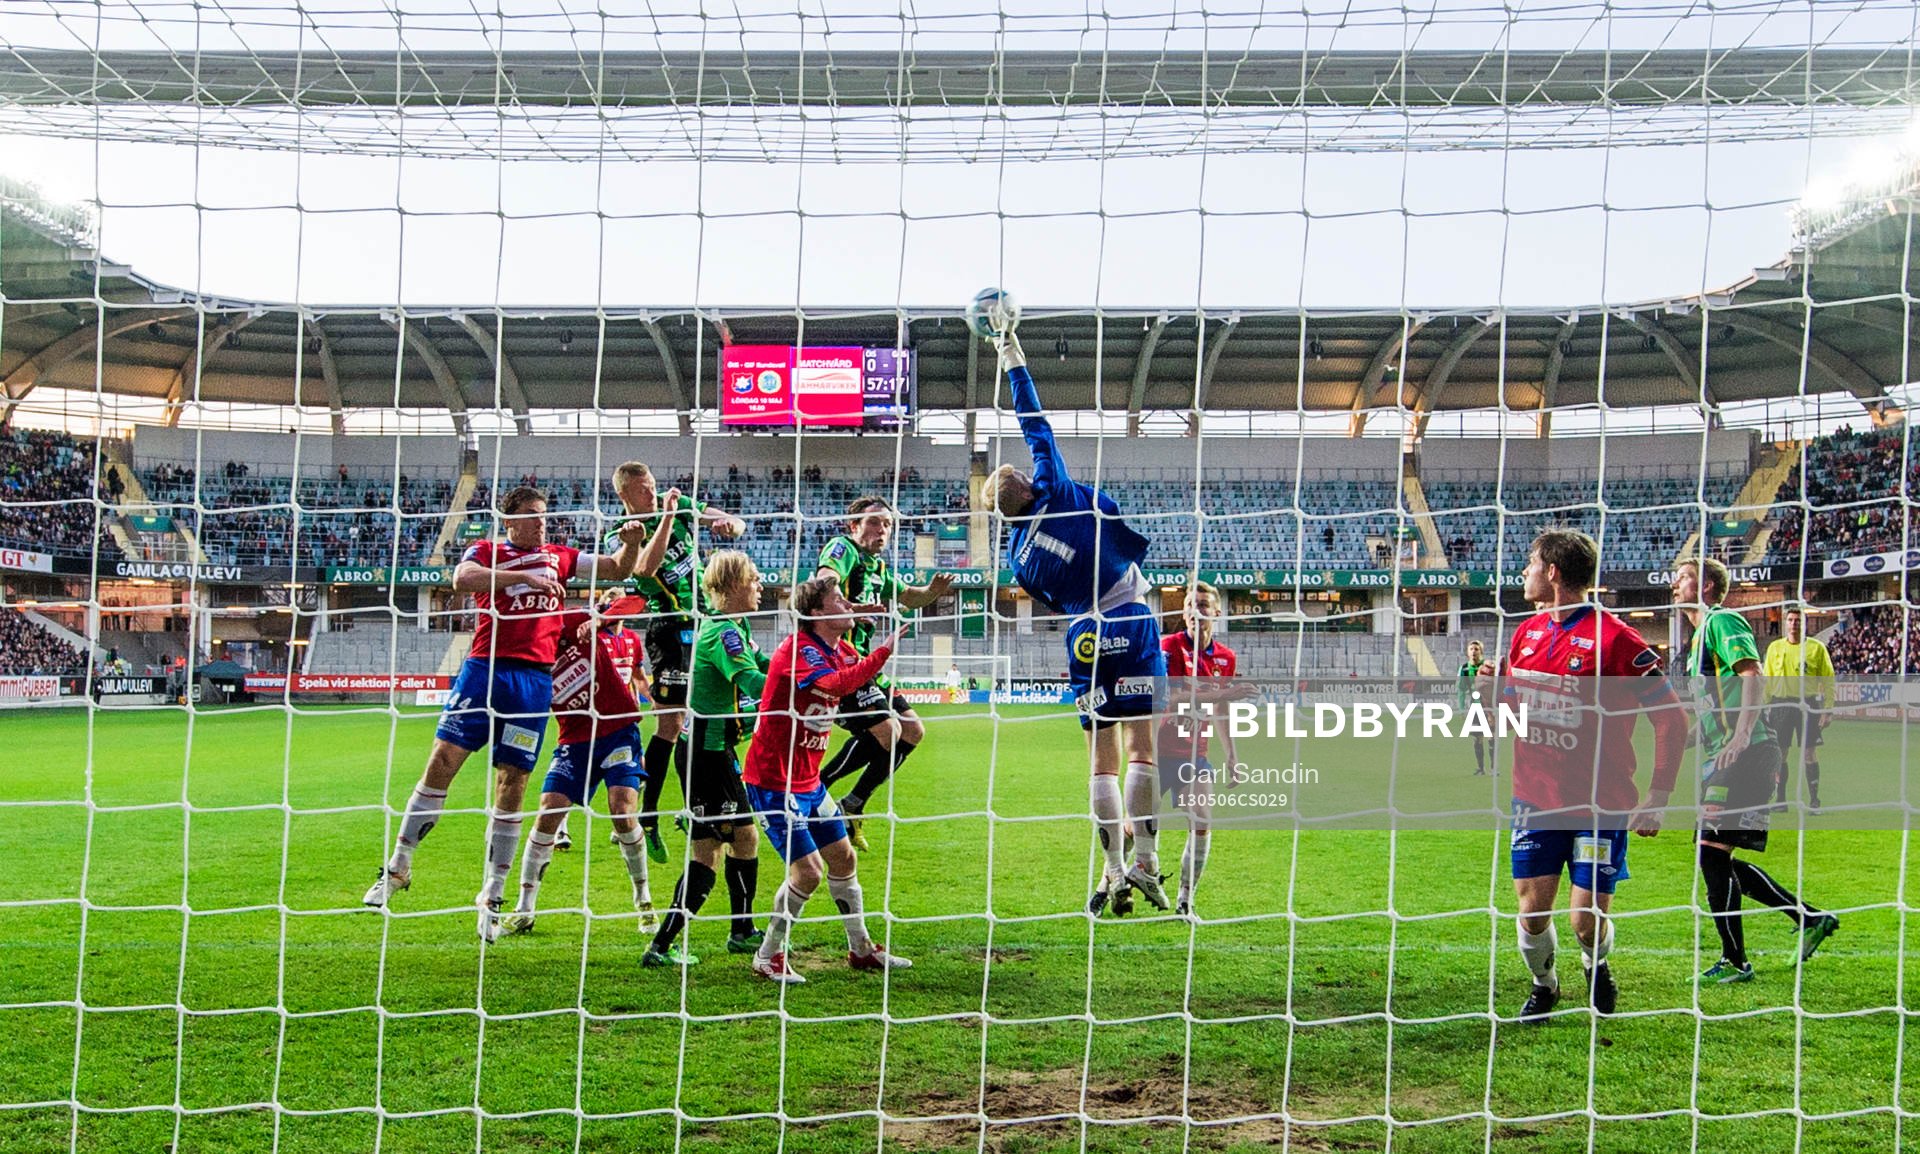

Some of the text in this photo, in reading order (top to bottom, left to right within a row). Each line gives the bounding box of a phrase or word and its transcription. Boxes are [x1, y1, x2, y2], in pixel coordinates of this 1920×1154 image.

[867, 359, 876, 371] 0
[867, 377, 905, 391] 57:17
[2, 550, 24, 568] GT
[116, 562, 242, 580] GAMLA ULLEVI
[333, 569, 373, 583] ÅBRO
[401, 569, 440, 583] ÅBRO
[759, 572, 779, 583] RO
[1214, 571, 1253, 584] ÅBRO
[1350, 572, 1389, 585] ÅBRO
[1417, 572, 1457, 585] ÅBRO
[510, 595, 559, 611] ÅBRO
[129, 679, 152, 693] ULLEVI
[299, 677, 329, 690] Spela
[331, 677, 348, 688] vid
[350, 677, 390, 688] sektion
[401, 677, 425, 688] eller
[427, 678, 436, 688] N
[1001, 682, 1042, 692] KMHO
[1119, 683, 1153, 694] RASTA
[1257, 683, 1291, 693] TYRES
[1323, 684, 1398, 694] KUMHO TYRES
[989, 689, 1063, 705] Björnkläder
[1834, 684, 1892, 702] NTERSPORT
[1521, 726, 1578, 750] BRO
[561, 745, 570, 757] 5
